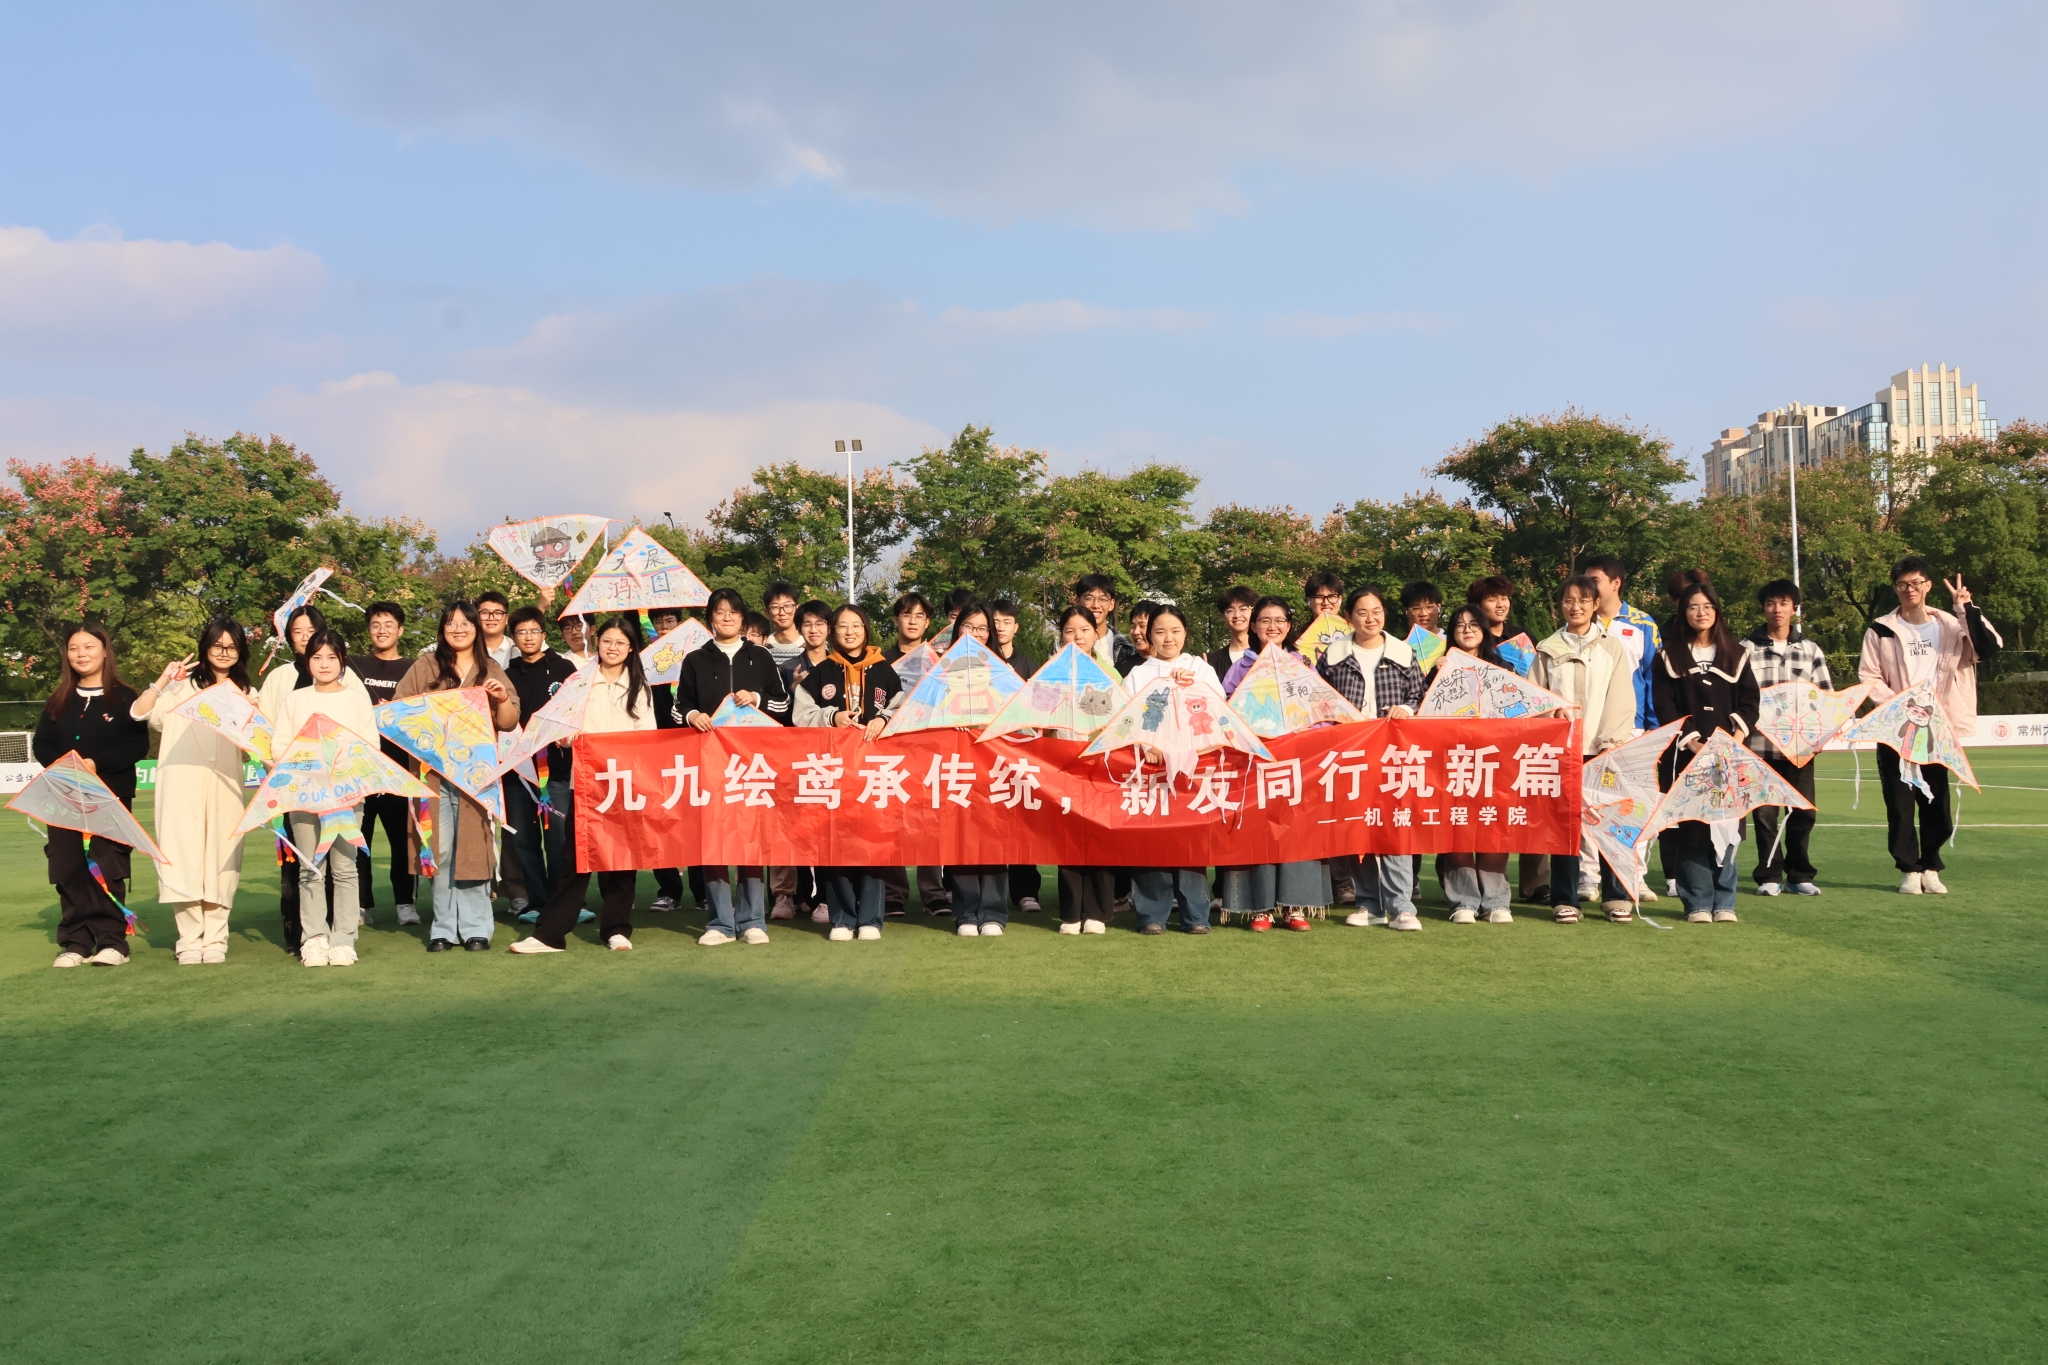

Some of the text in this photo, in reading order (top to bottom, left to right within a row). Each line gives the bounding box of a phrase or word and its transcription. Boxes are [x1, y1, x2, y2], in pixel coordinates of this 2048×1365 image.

[364, 677, 398, 689] COMMENT
[1283, 681, 1309, 698] 重阳
[298, 777, 363, 804] OUR DAY
